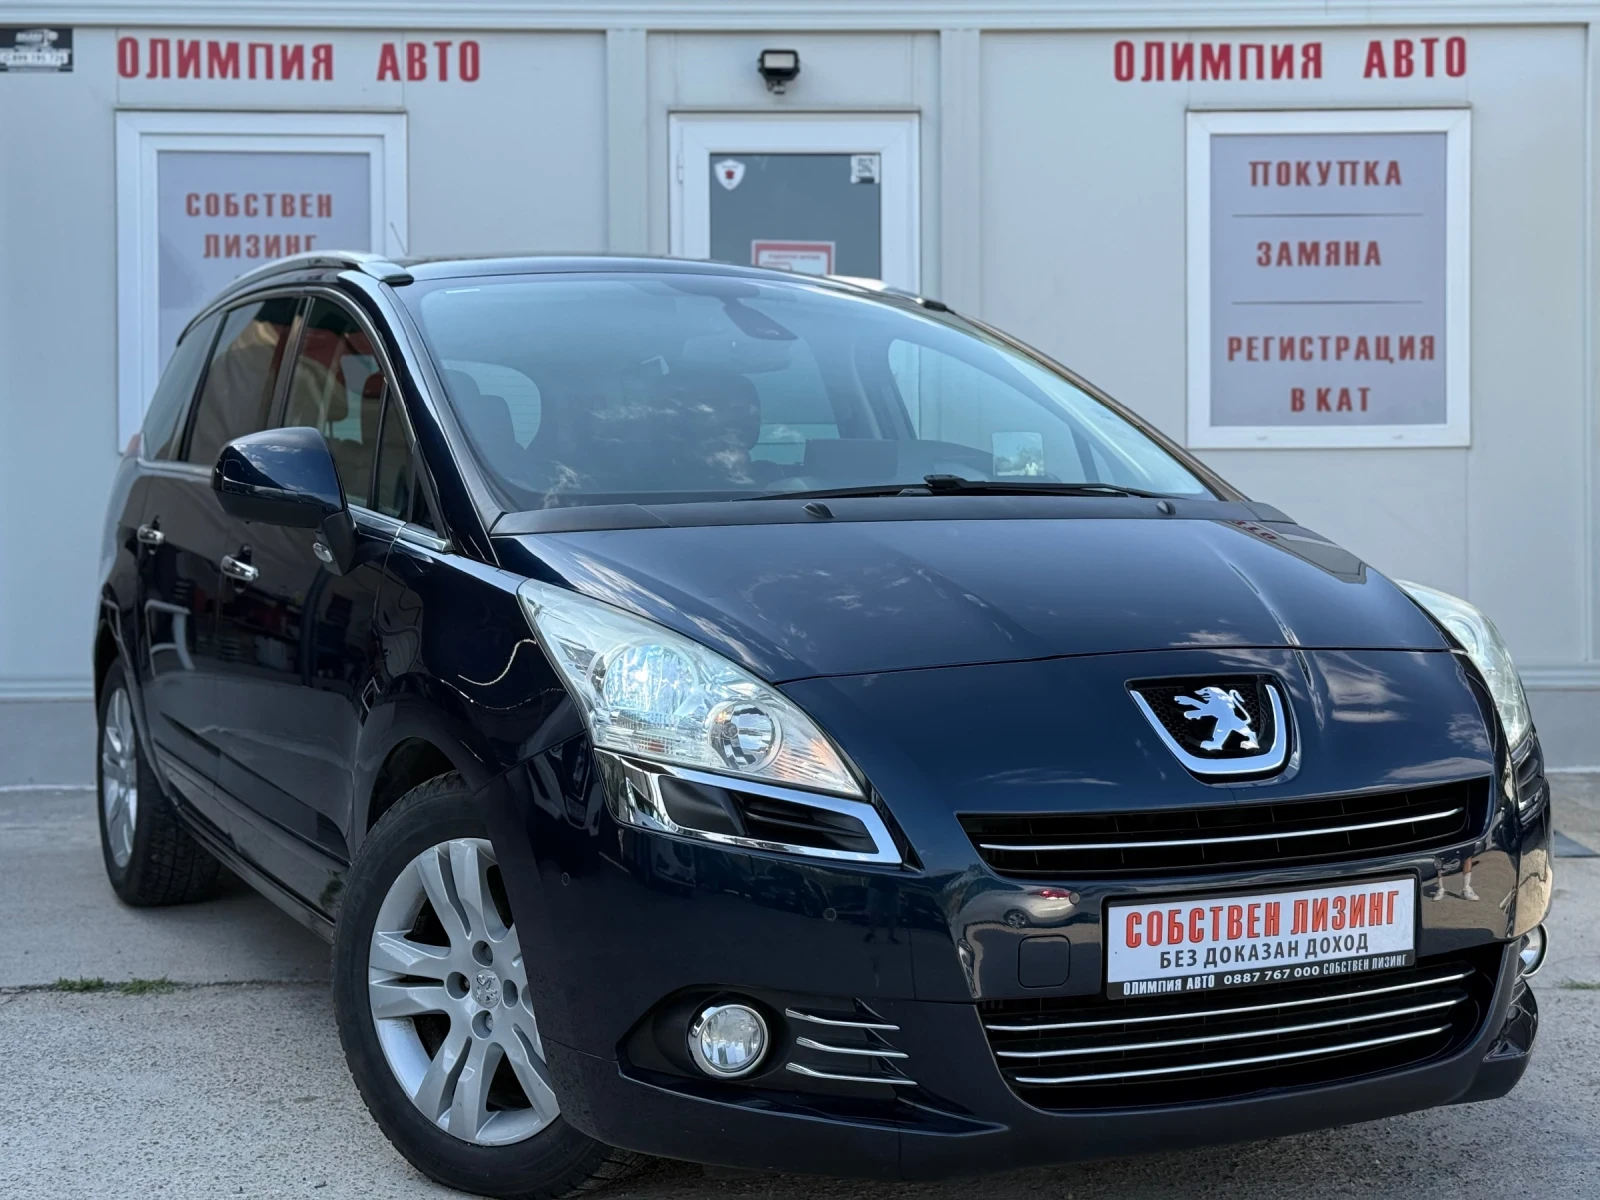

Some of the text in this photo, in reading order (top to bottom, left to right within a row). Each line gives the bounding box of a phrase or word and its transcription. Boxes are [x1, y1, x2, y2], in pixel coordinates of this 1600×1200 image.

[117, 36, 480, 82] ОЛИМПИЯ АВТО
[1114, 36, 1467, 82] ОЛИМПИЯ АВТО
[1249, 160, 1402, 187] ПОКУПКА
[185, 192, 333, 219] СОБСТВЕН
[203, 234, 318, 259] ЛИЗИНГ
[1256, 240, 1382, 268] ЗАМЯНА
[1227, 335, 1435, 364] РЕГИСТРАЦИЯ
[1290, 386, 1371, 413] В КАТ
[1125, 890, 1400, 948] СОБСТВЕН ЛИЗИНГ
[1159, 932, 1369, 969] БЕЗ ДОКАЗАН ДОХОД
[1122, 954, 1408, 996] ОЛИМПИЯ АВТО 0887 767 000 СОБСТВЕН ЛИЗИНГ
